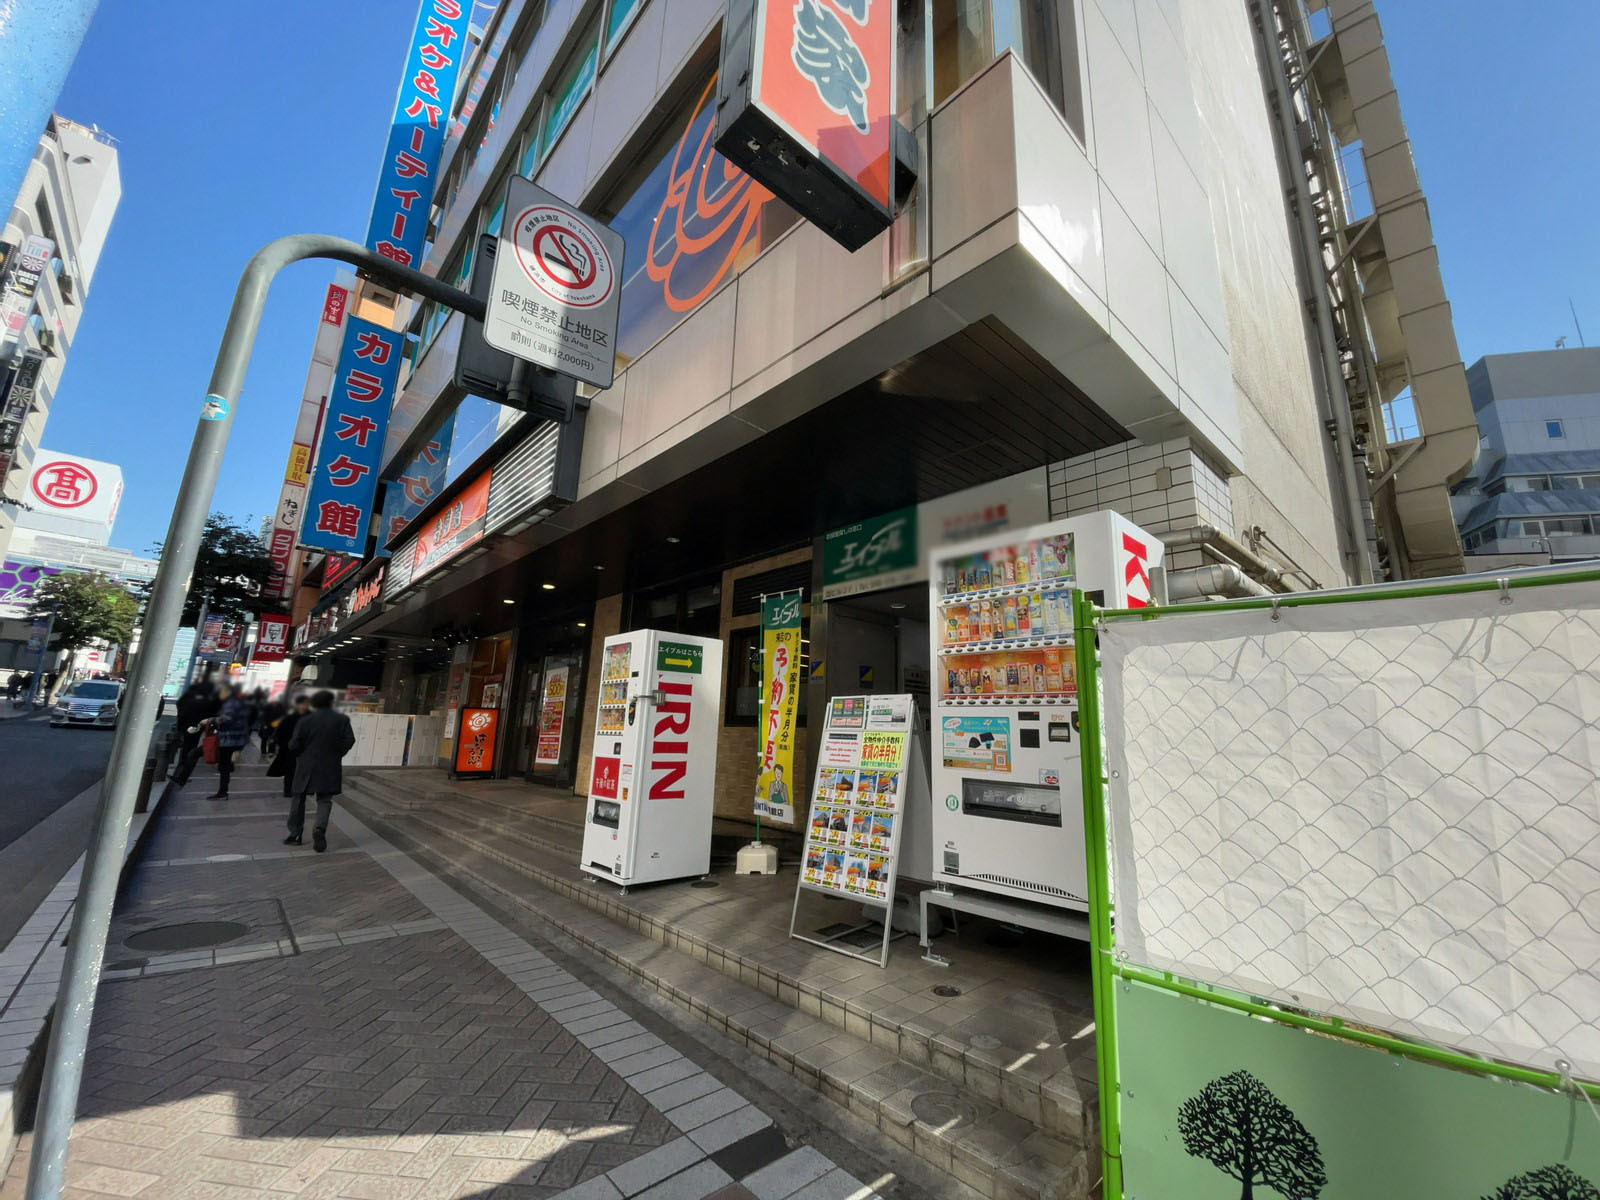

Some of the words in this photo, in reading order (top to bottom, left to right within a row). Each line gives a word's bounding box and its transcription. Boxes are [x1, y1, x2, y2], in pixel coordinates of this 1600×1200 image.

[567, 220, 577, 231] No
[579, 227, 600, 257] Smoking
[597, 256, 605, 273] Area
[501, 289, 609, 348] 喫煙禁止地区
[520, 315, 533, 326] No
[534, 321, 569, 343] Smoking
[570, 337, 589, 350] Area
[315, 331, 393, 539] カラオケ館
[257, 645, 285, 654] KFC
[658, 646, 703, 657] エイブルはこちら
[649, 674, 693, 800] IRIN
